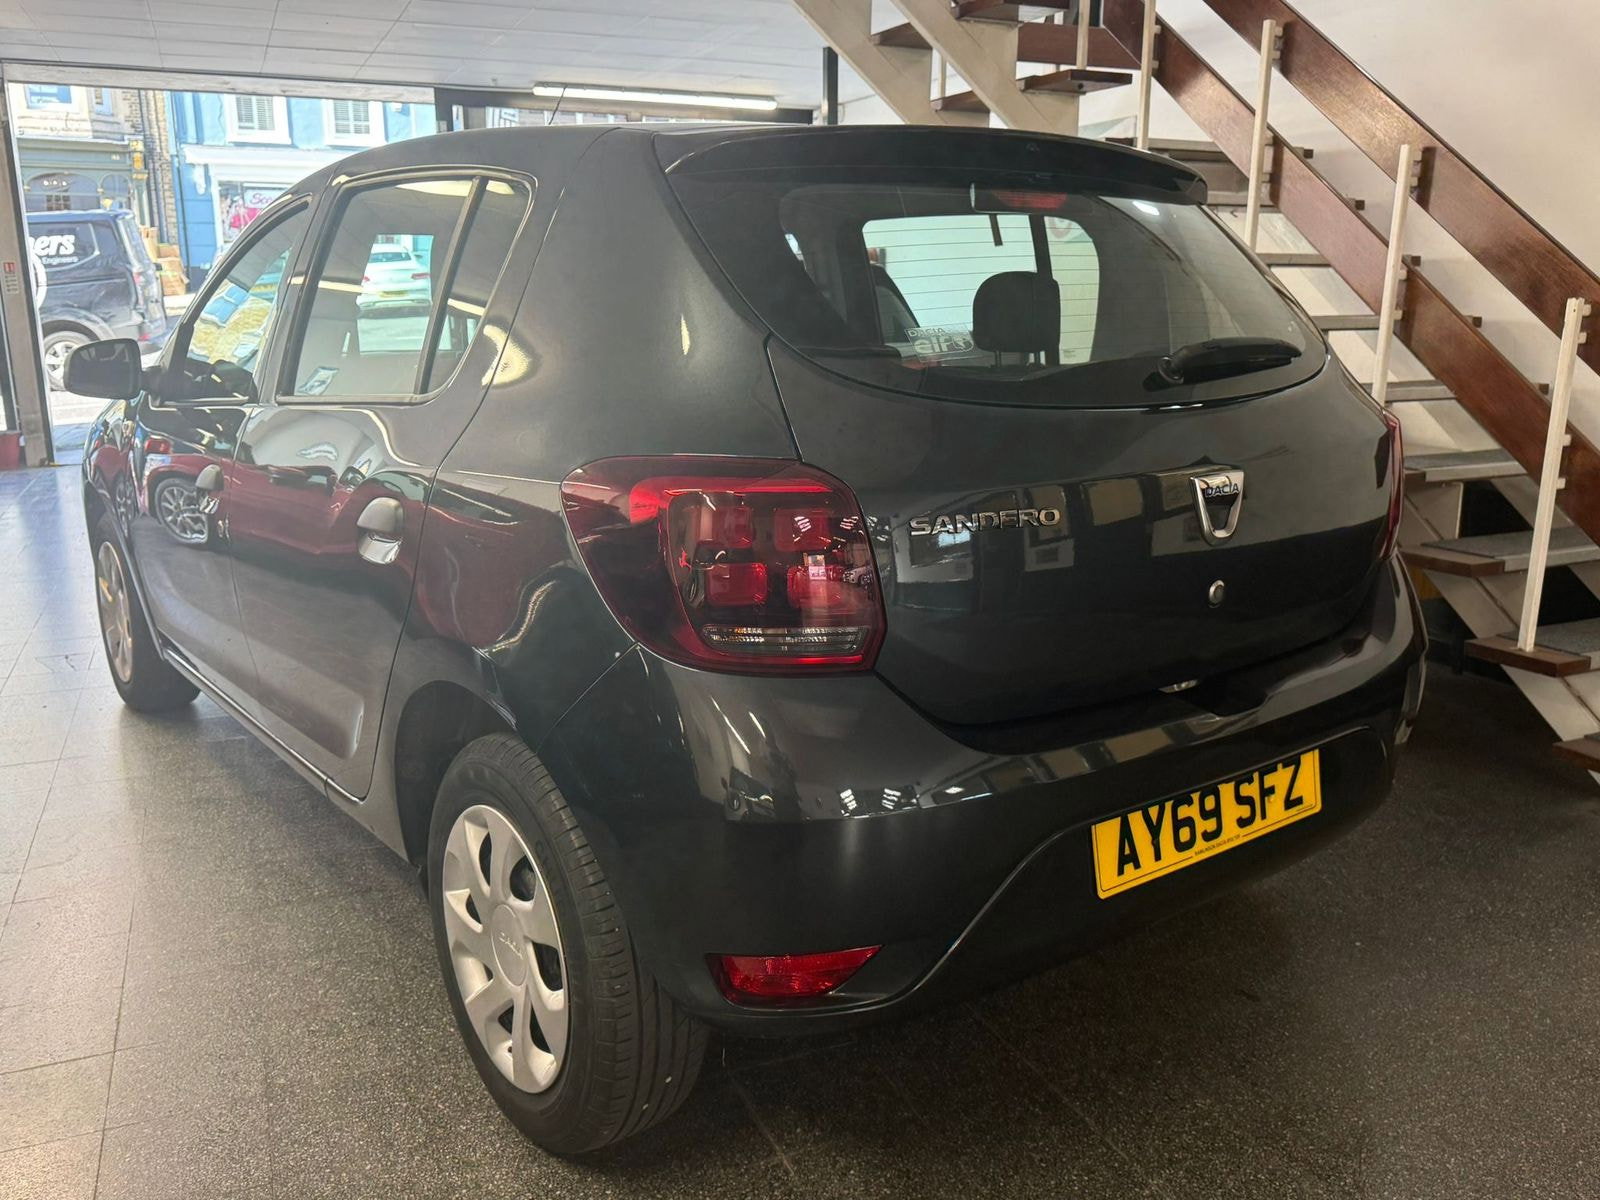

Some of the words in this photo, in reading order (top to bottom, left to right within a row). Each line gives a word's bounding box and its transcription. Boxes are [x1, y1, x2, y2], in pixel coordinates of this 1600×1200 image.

[1205, 482, 1240, 498] DACIA
[909, 508, 1061, 536] SANDERO
[1117, 785, 1223, 877] AY69
[1233, 756, 1304, 829] SFZ
